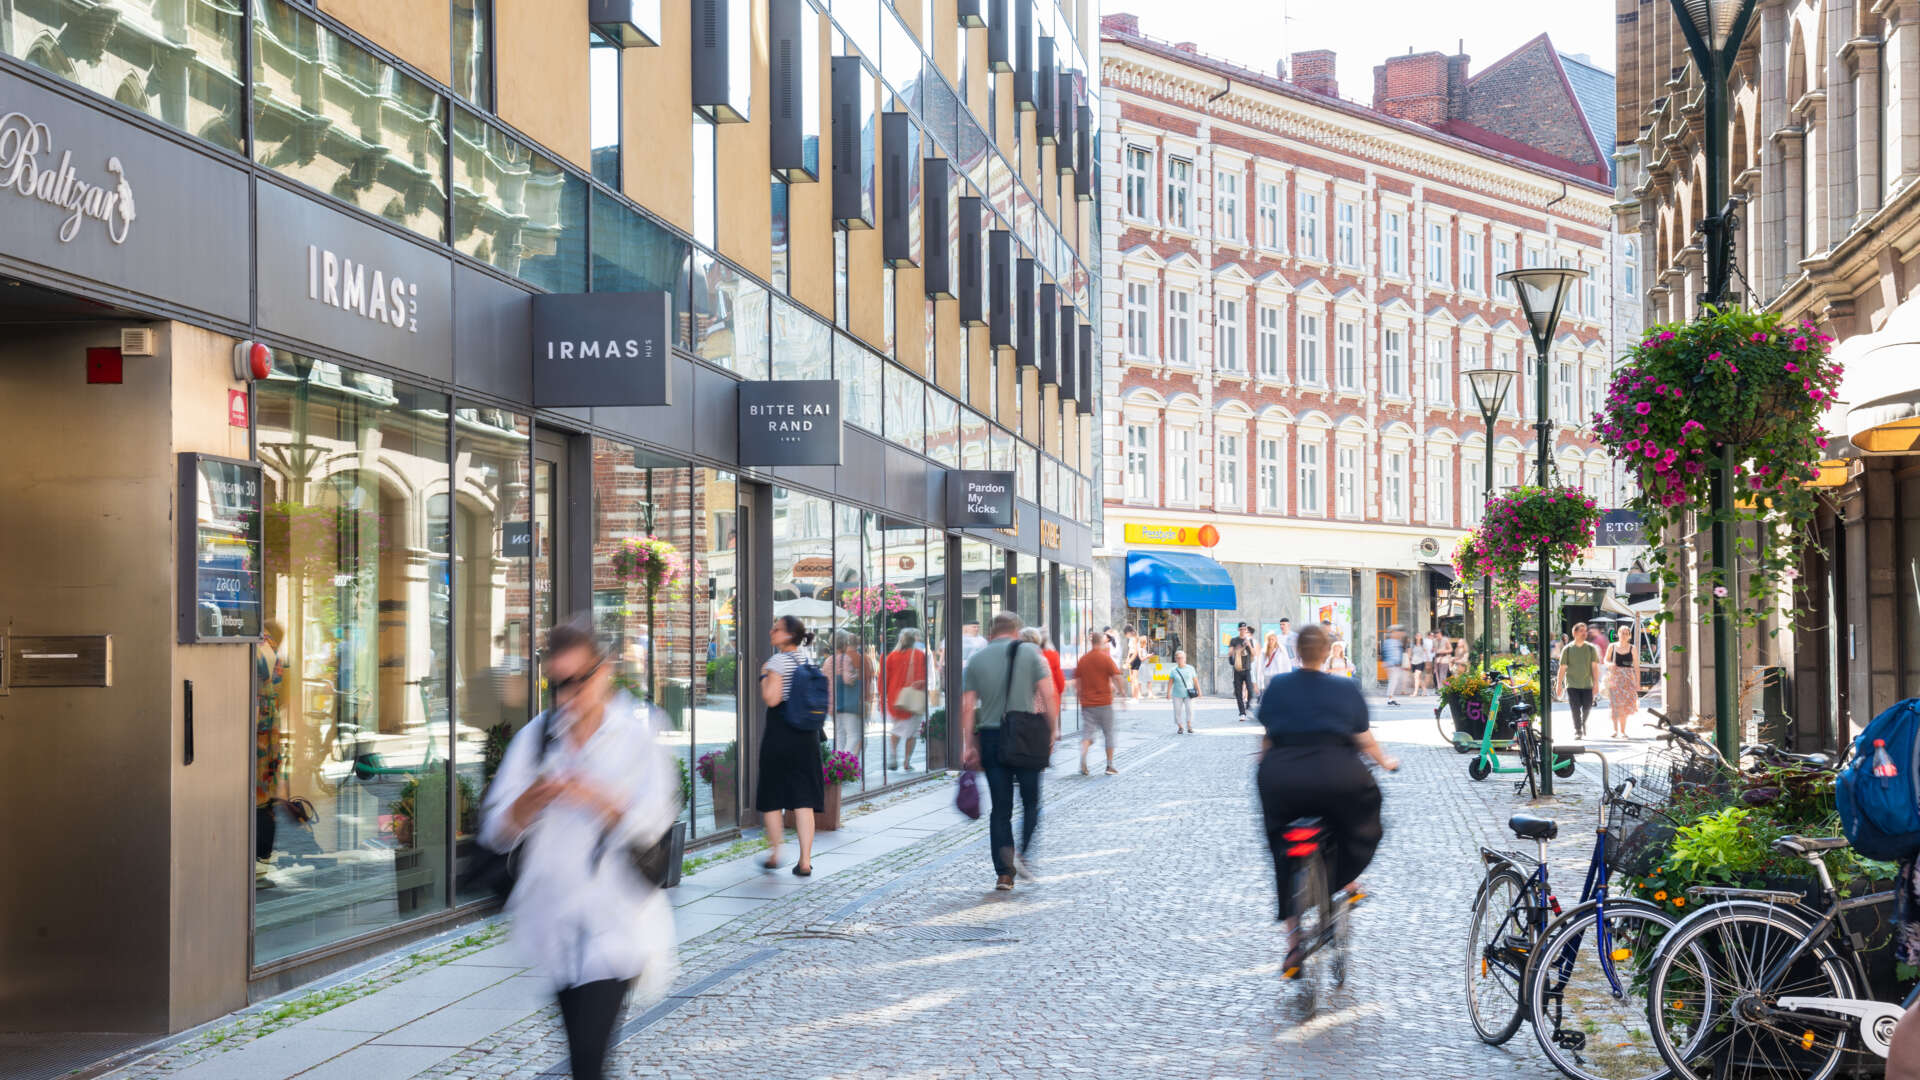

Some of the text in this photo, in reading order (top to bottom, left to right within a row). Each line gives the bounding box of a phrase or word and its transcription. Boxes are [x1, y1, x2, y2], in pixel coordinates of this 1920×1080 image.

[0, 112, 136, 243] Baltzar
[308, 244, 406, 328] IRMAS
[547, 339, 639, 360] IRMAS
[750, 404, 830, 416] BITTE KAI
[768, 421, 813, 432] RAND
[246, 481, 256, 497] 30
[968, 483, 1005, 493] Pardon
[968, 494, 983, 504] My
